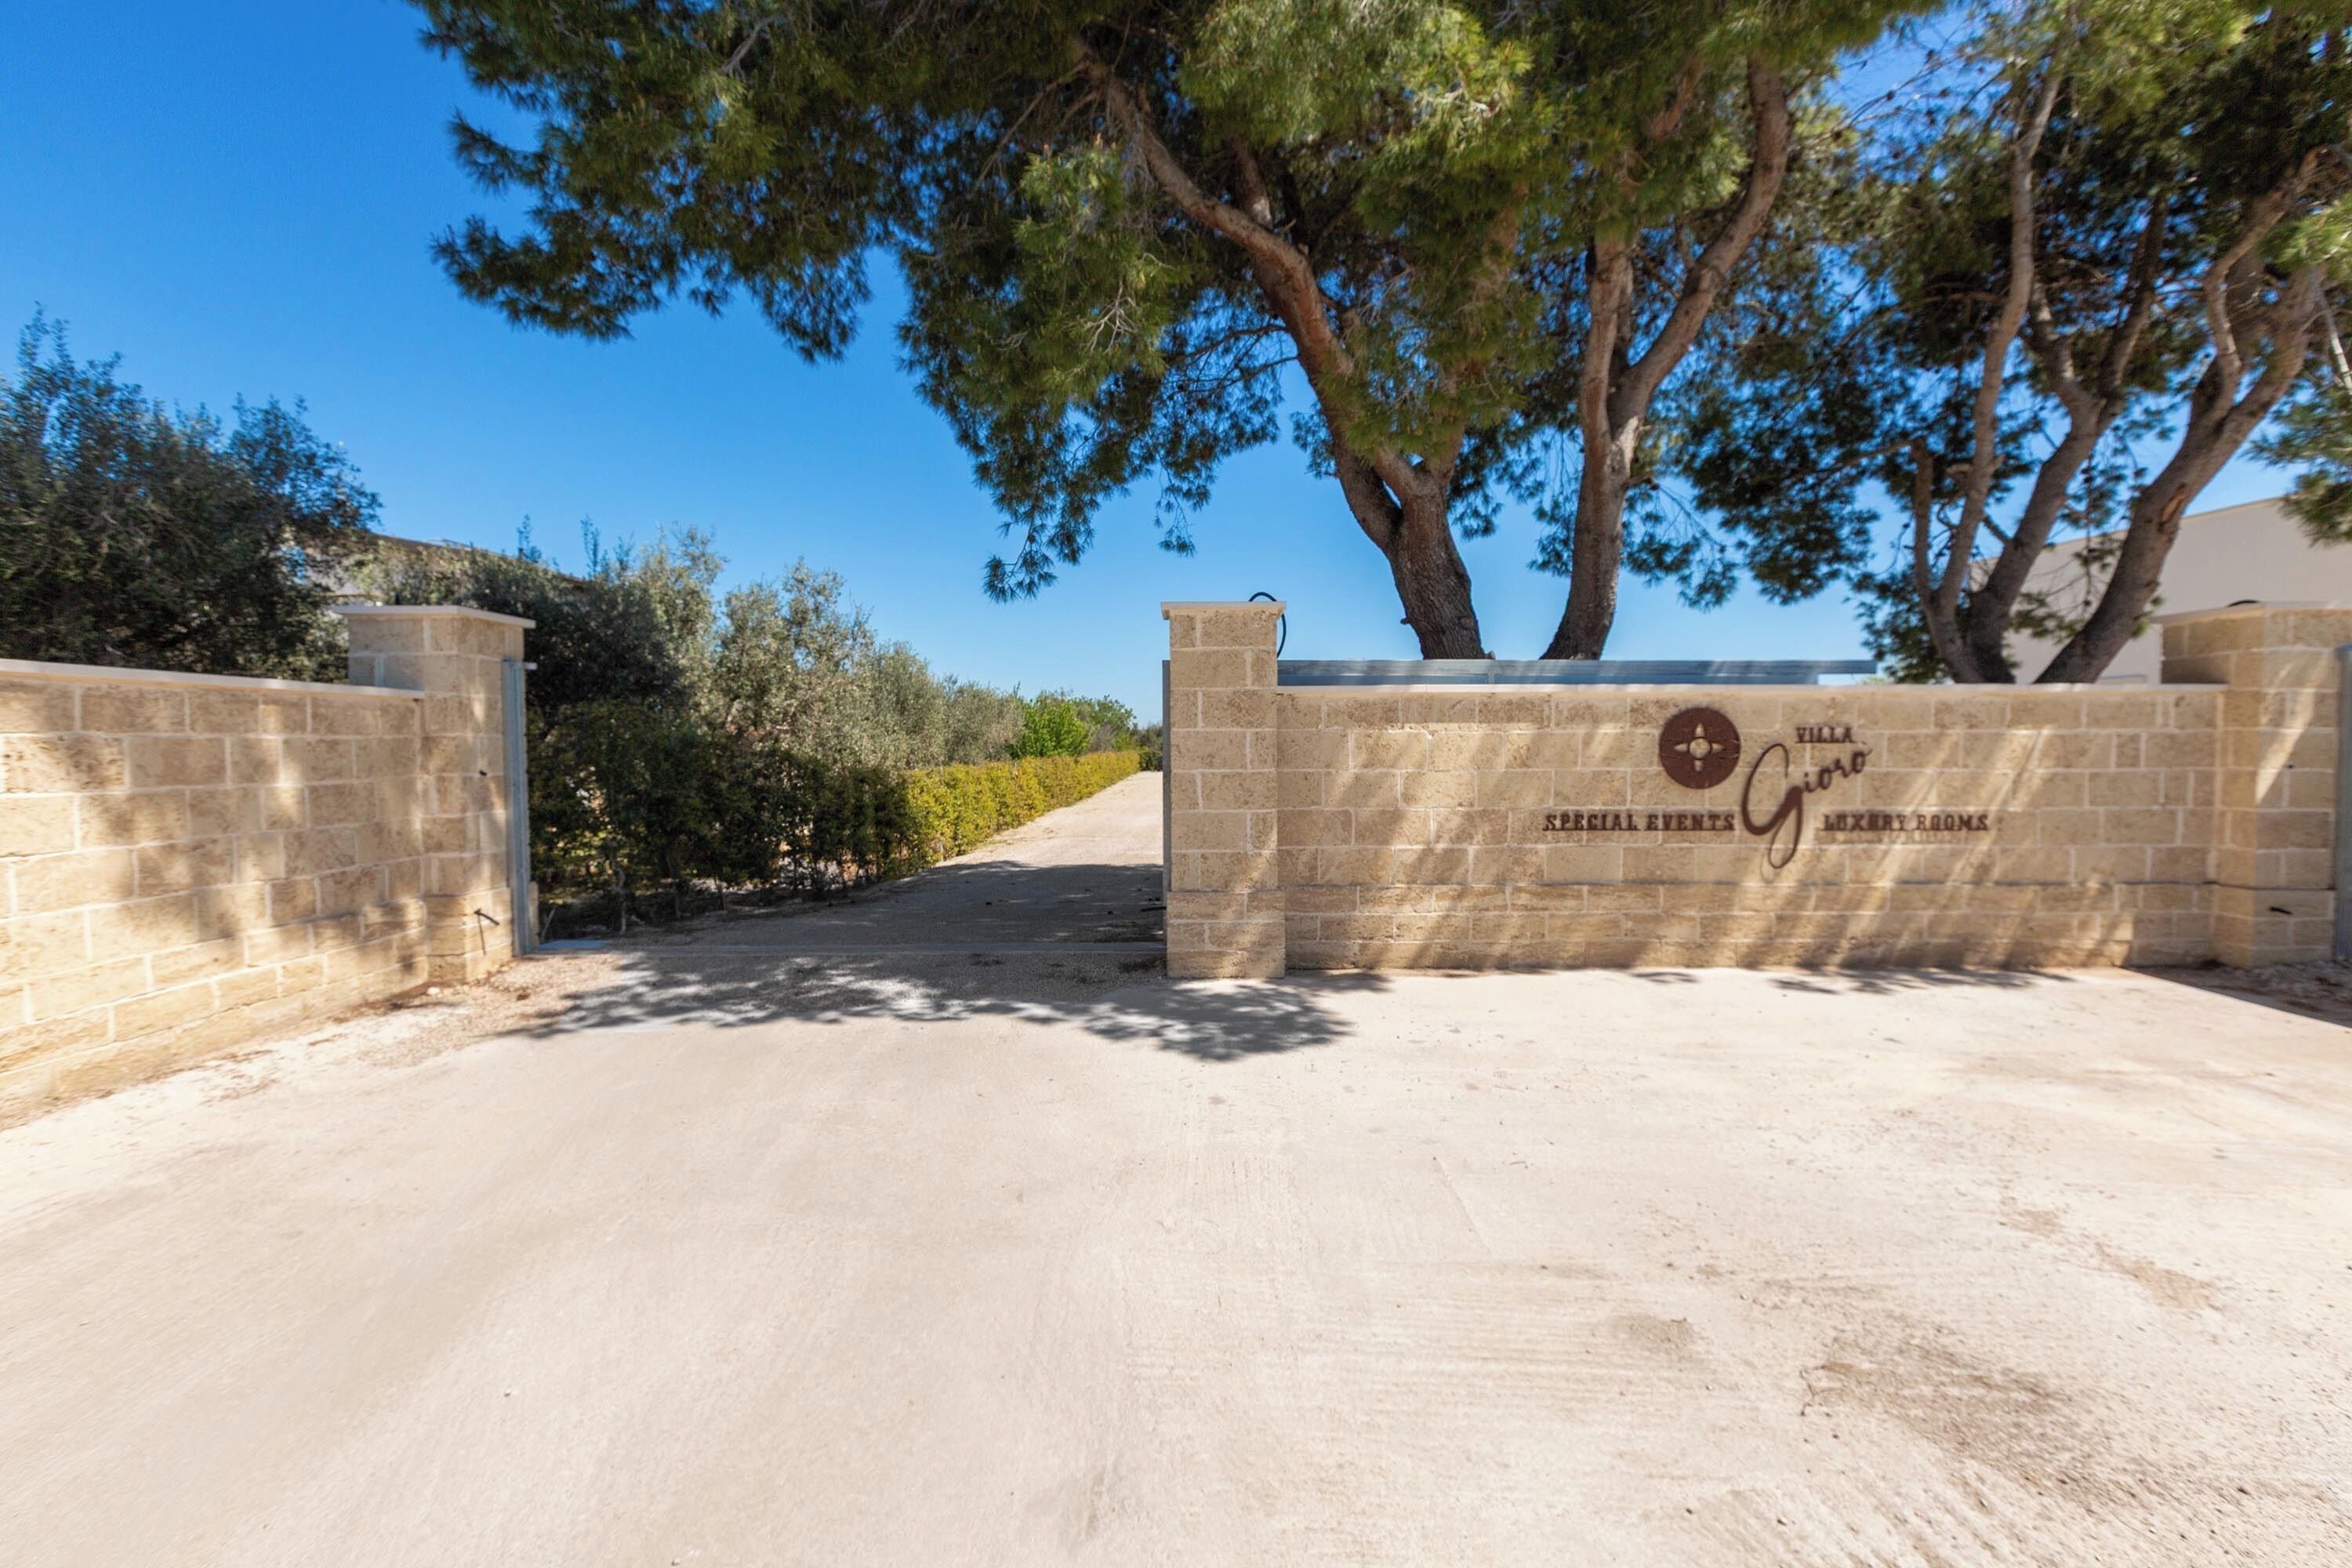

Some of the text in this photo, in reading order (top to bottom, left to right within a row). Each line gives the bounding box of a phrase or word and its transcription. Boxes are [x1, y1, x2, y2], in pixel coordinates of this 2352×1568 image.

[1796, 726, 1856, 743] VILLA
[1543, 814, 1735, 831] SPECIAL EVENTS
[1821, 814, 1989, 831] LUXURY ROOMS
